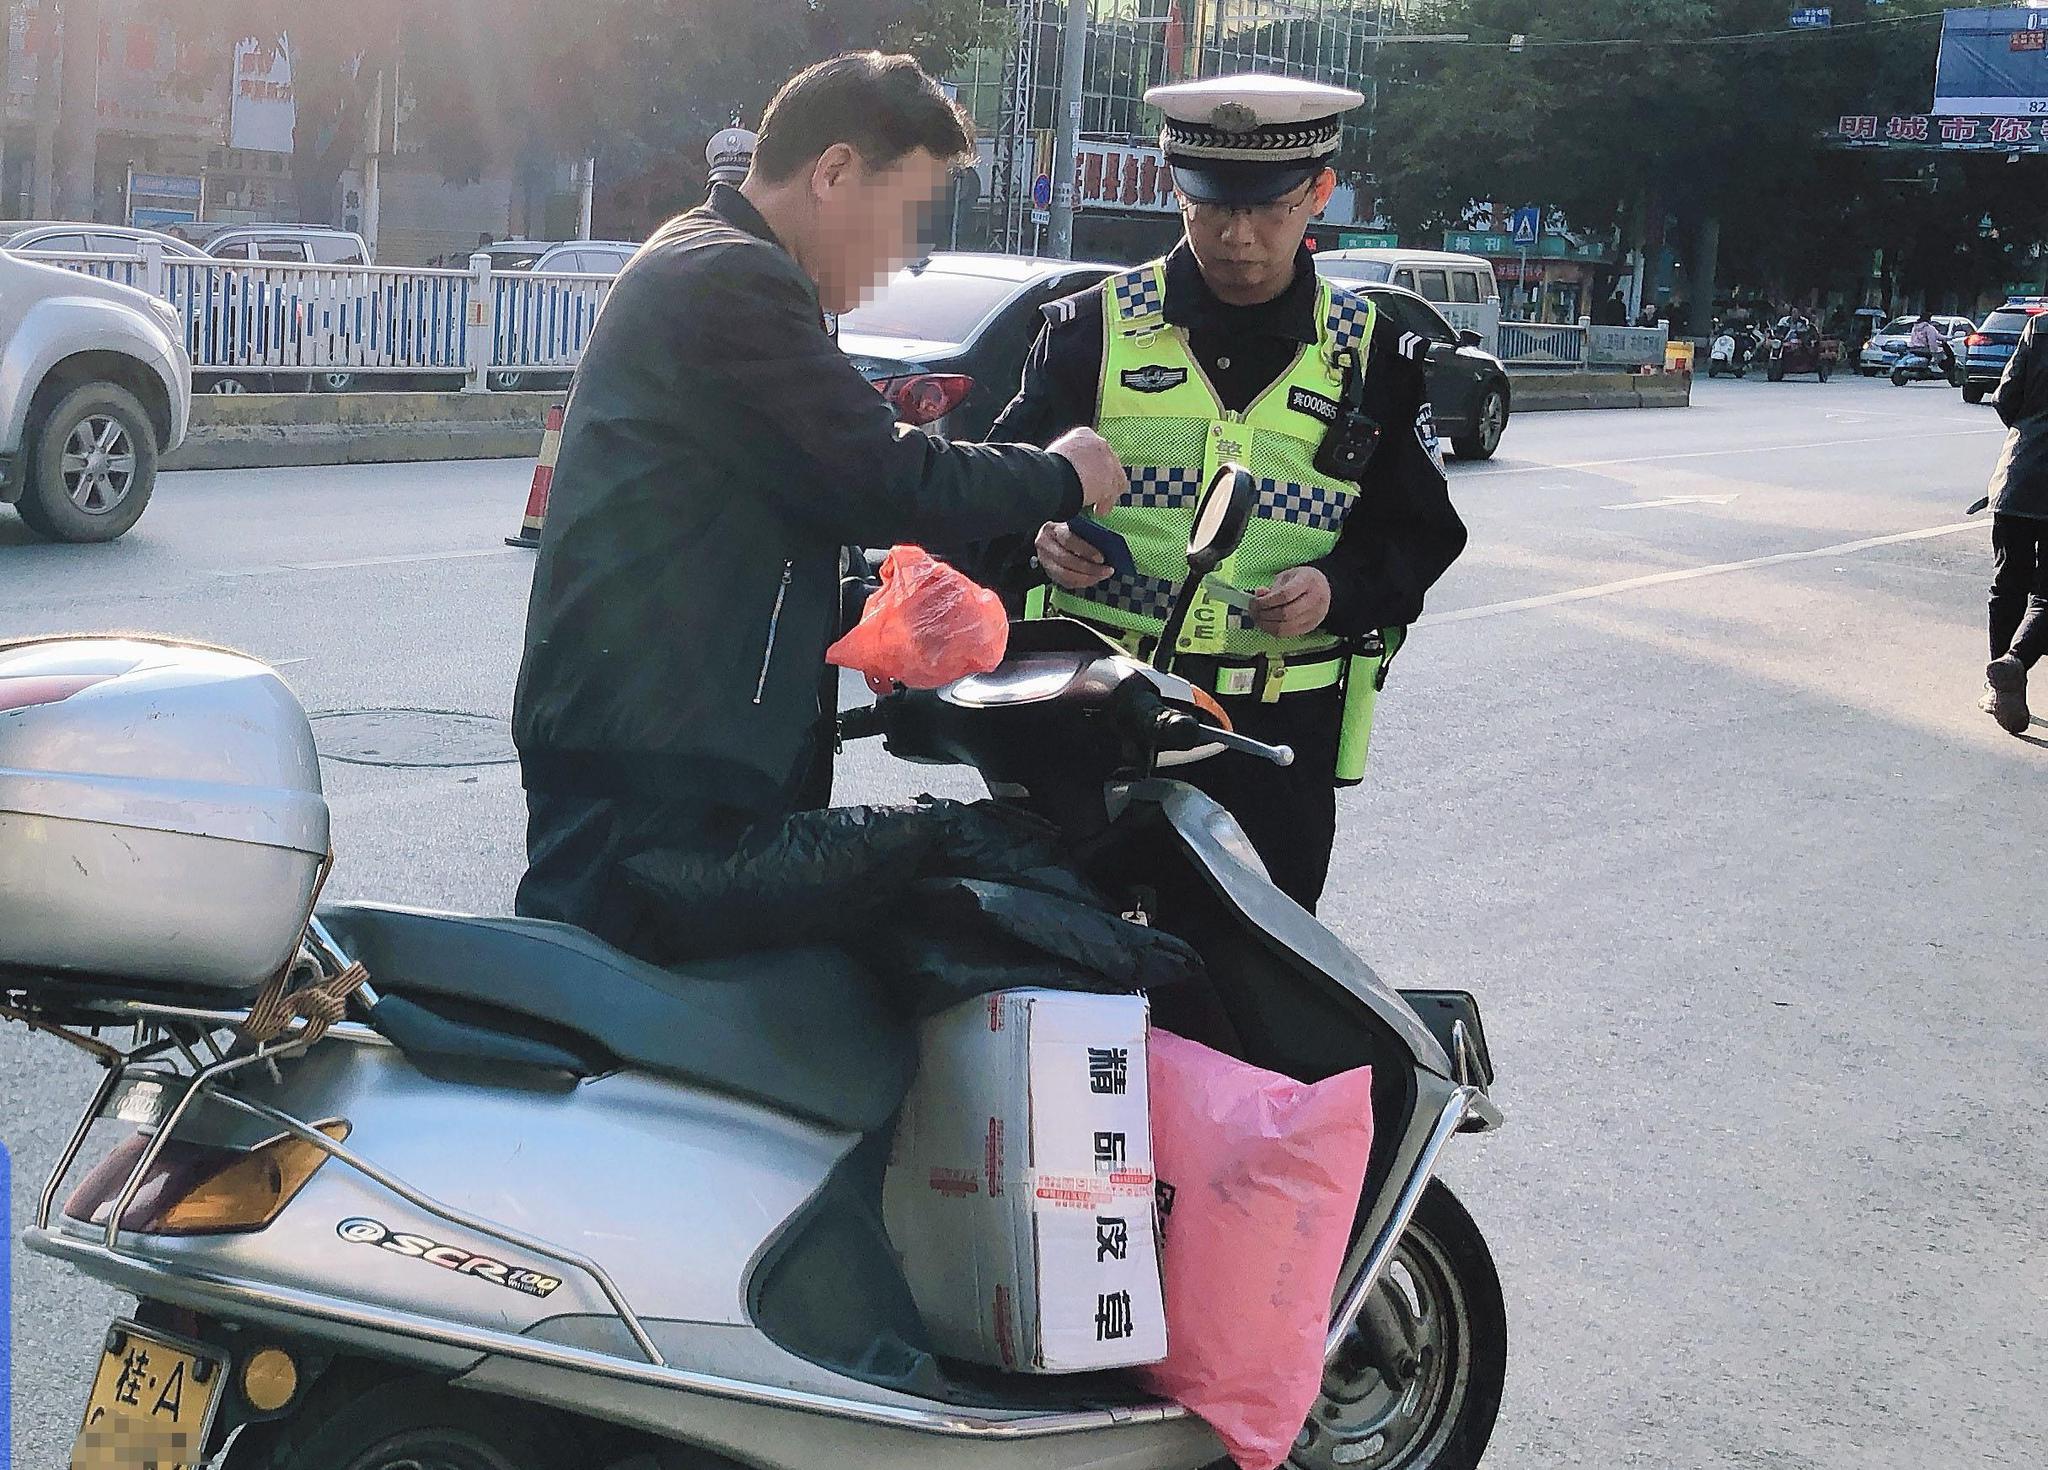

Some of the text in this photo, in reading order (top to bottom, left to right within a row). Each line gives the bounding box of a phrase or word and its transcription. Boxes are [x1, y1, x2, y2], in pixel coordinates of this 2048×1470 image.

[2029, 101, 2048, 113] 82
[1838, 116, 2048, 142] 明城市你
[1087, 1047, 1134, 1342] 精品皮草
